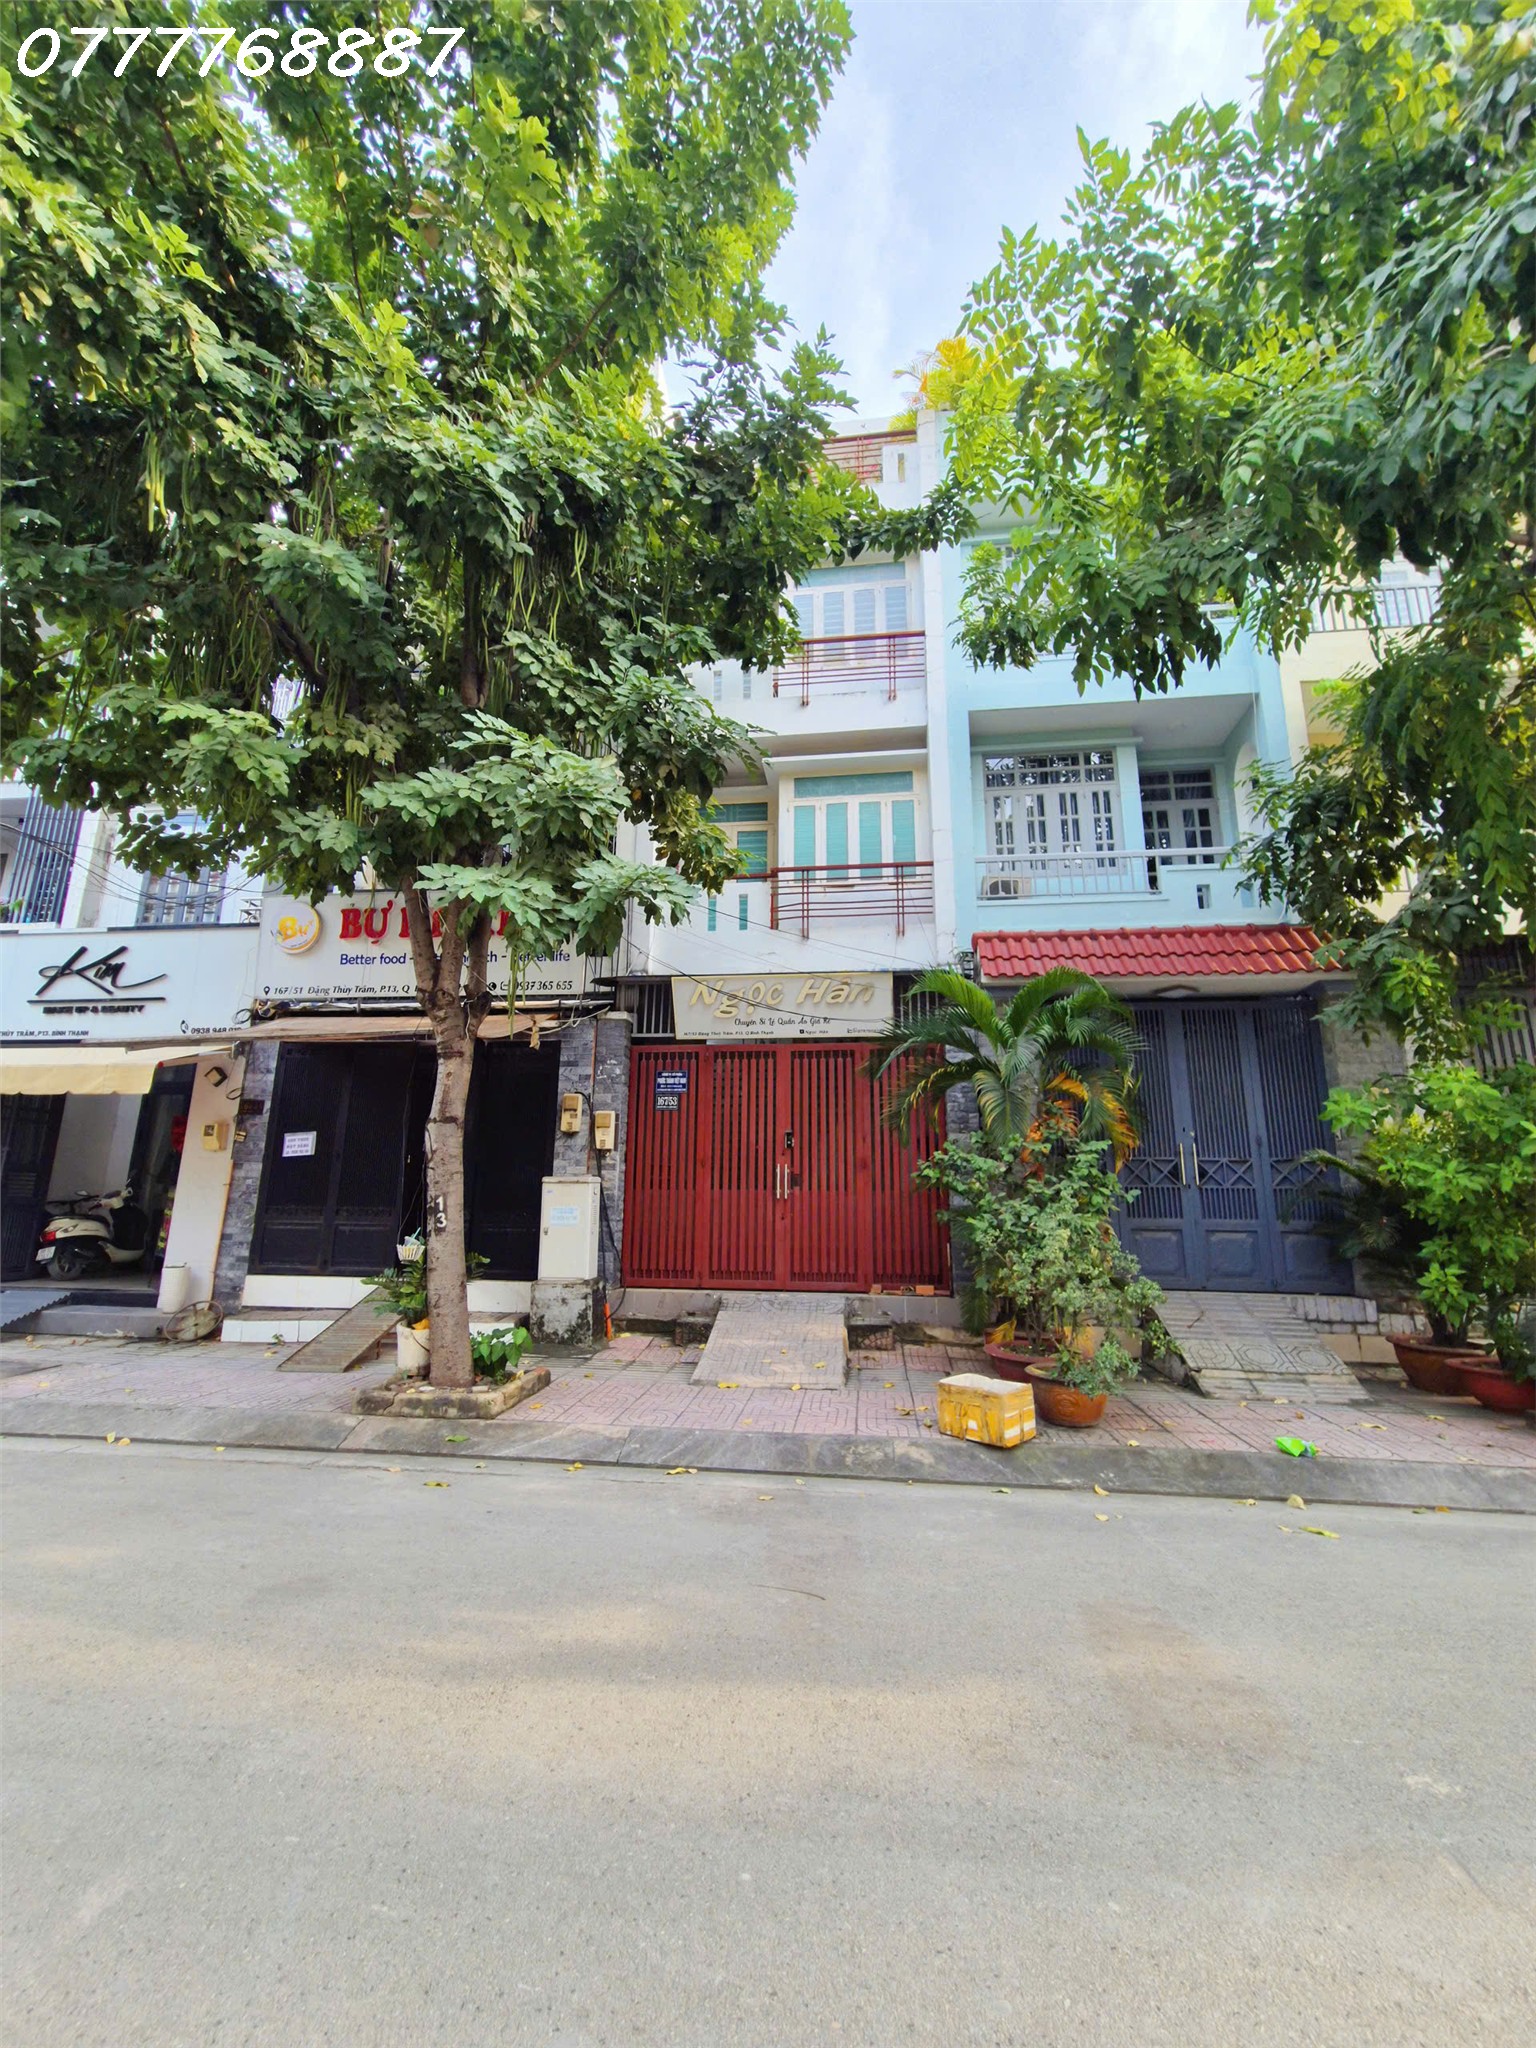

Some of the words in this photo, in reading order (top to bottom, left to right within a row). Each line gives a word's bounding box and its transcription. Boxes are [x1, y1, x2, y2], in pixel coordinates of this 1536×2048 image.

[340, 953, 377, 965] Better
[380, 953, 407, 964] food
[274, 986, 303, 995] 167/51
[537, 981, 553, 990] 365
[556, 981, 572, 990] 655
[688, 979, 785, 1019] Ngọc
[796, 977, 875, 1004] Hân
